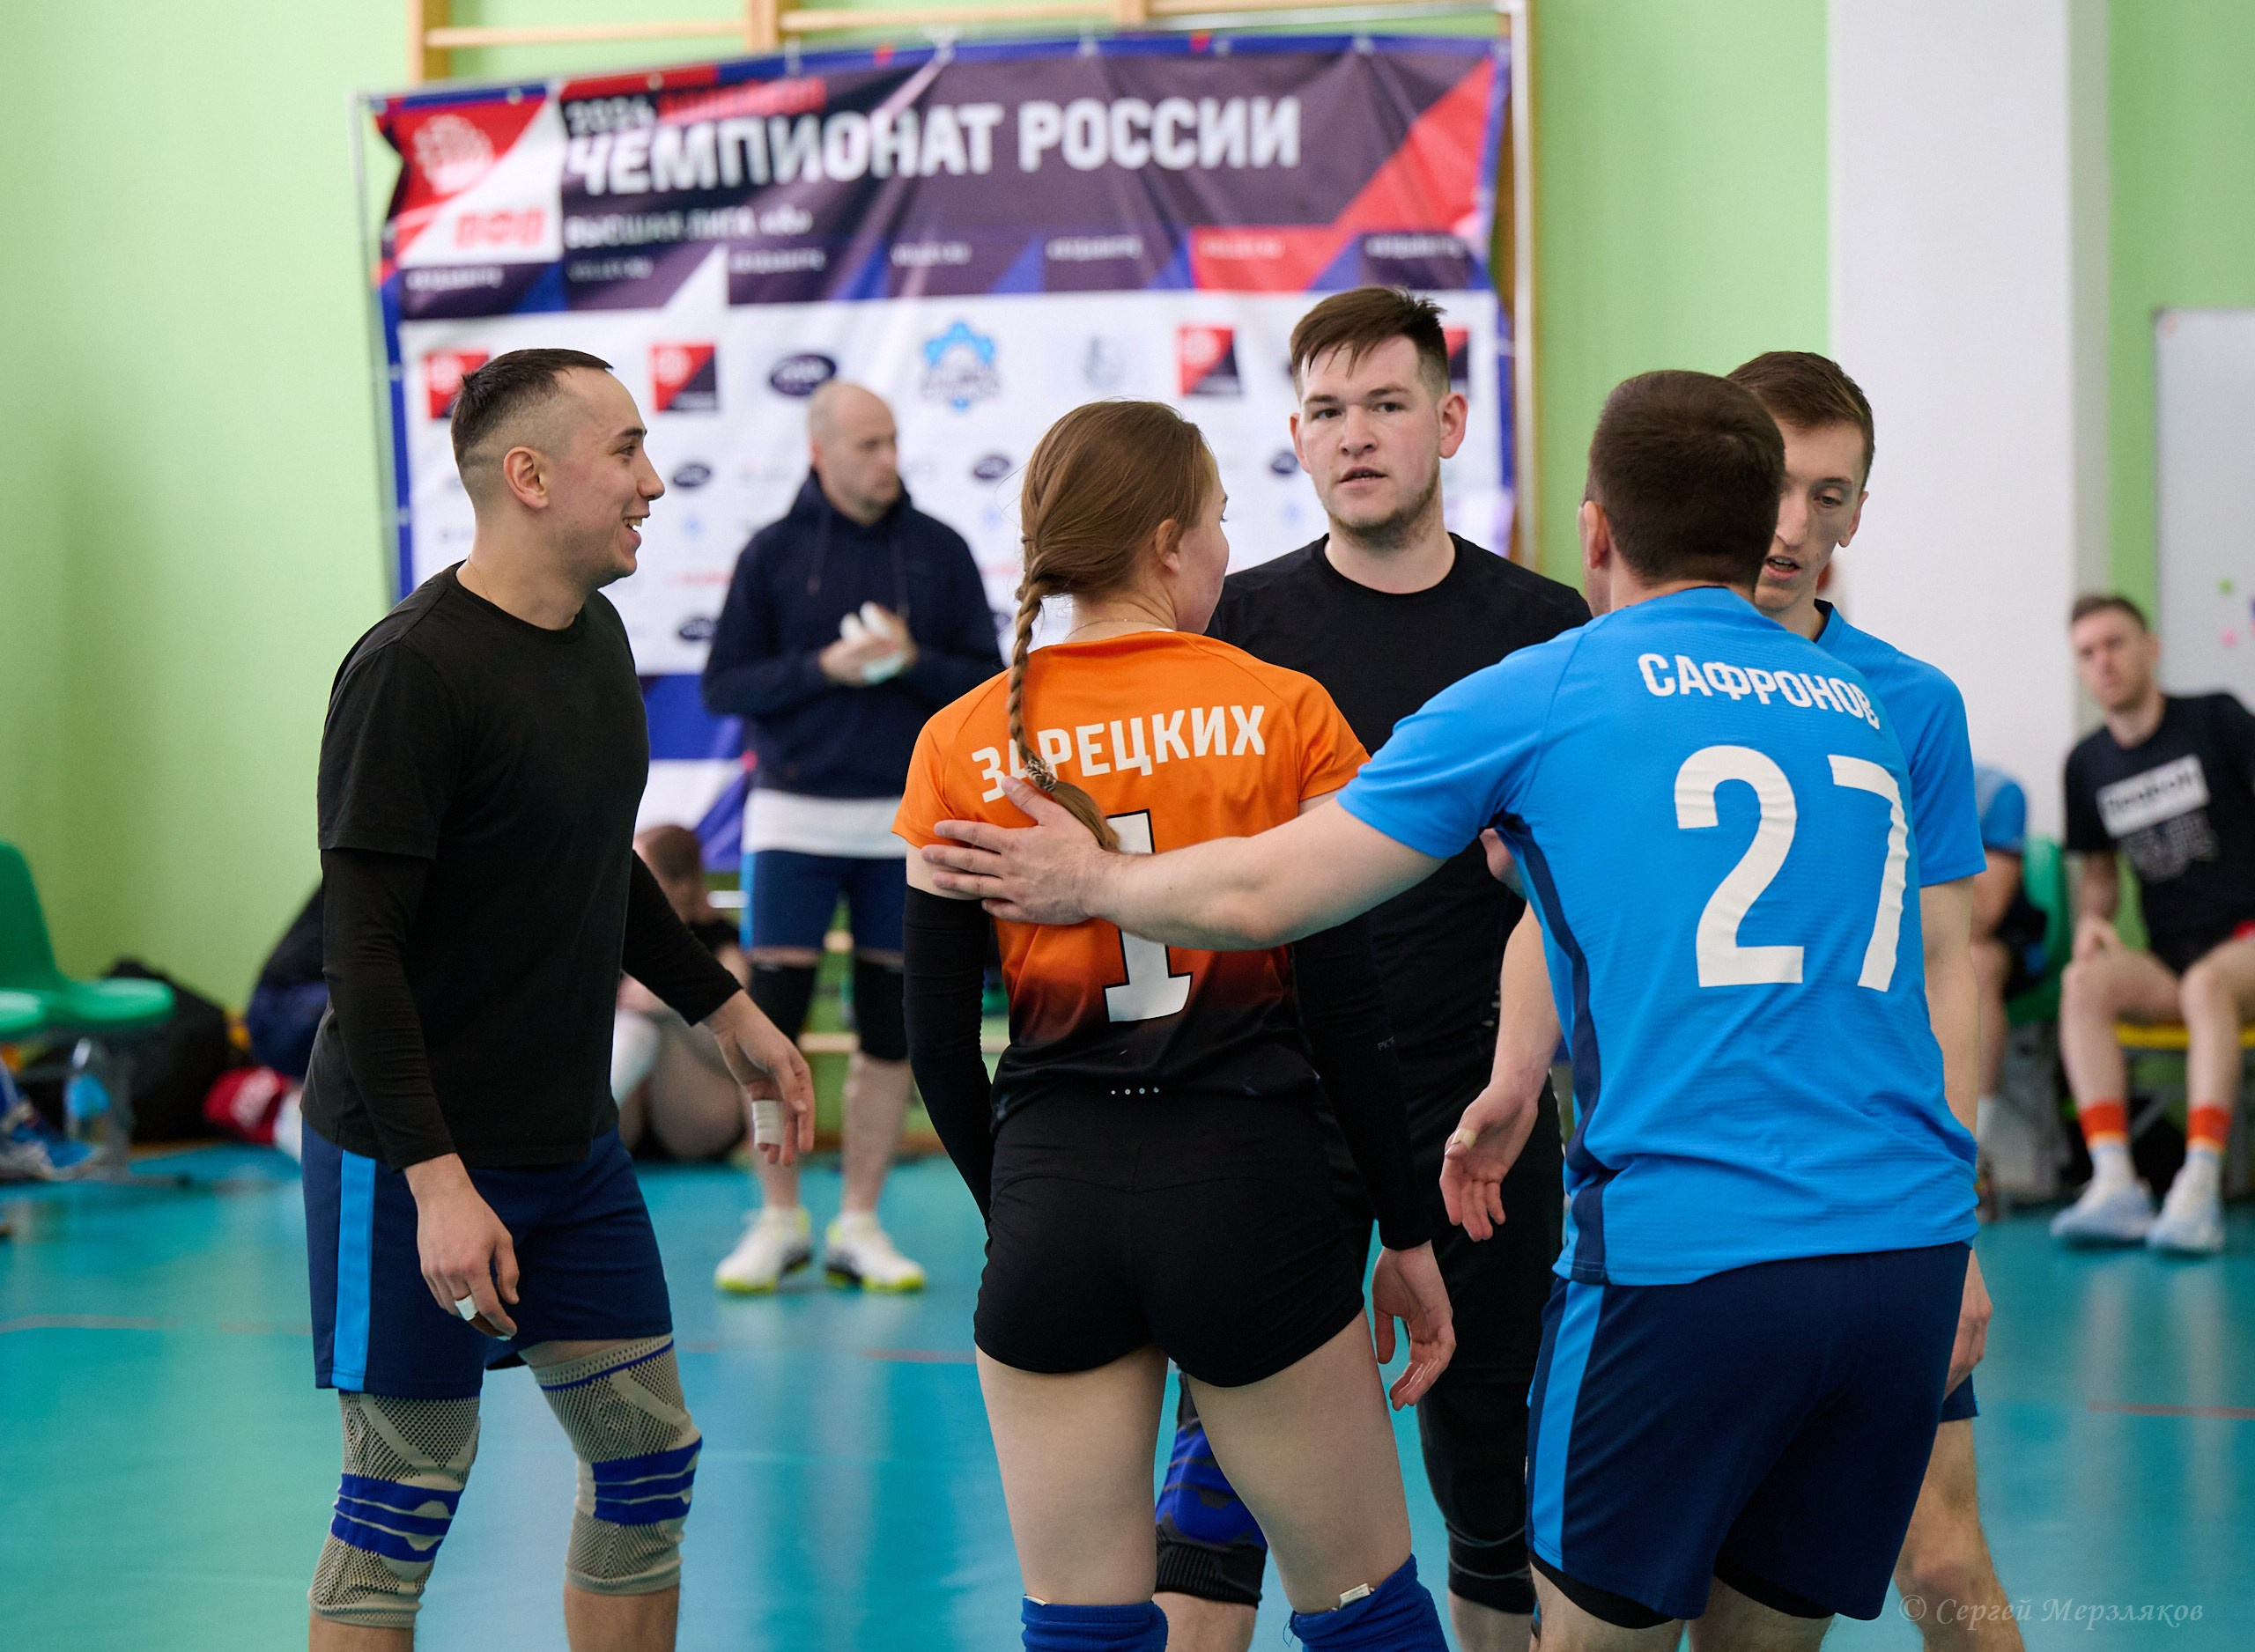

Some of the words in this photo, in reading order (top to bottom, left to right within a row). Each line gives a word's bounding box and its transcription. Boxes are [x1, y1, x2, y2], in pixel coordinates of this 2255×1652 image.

[568, 101, 1004, 194] ЧЕМПИОНАТ
[1017, 95, 1301, 173] РОССИИ
[1637, 653, 1880, 730] САФРОНОВ
[1674, 745, 1910, 992] 27
